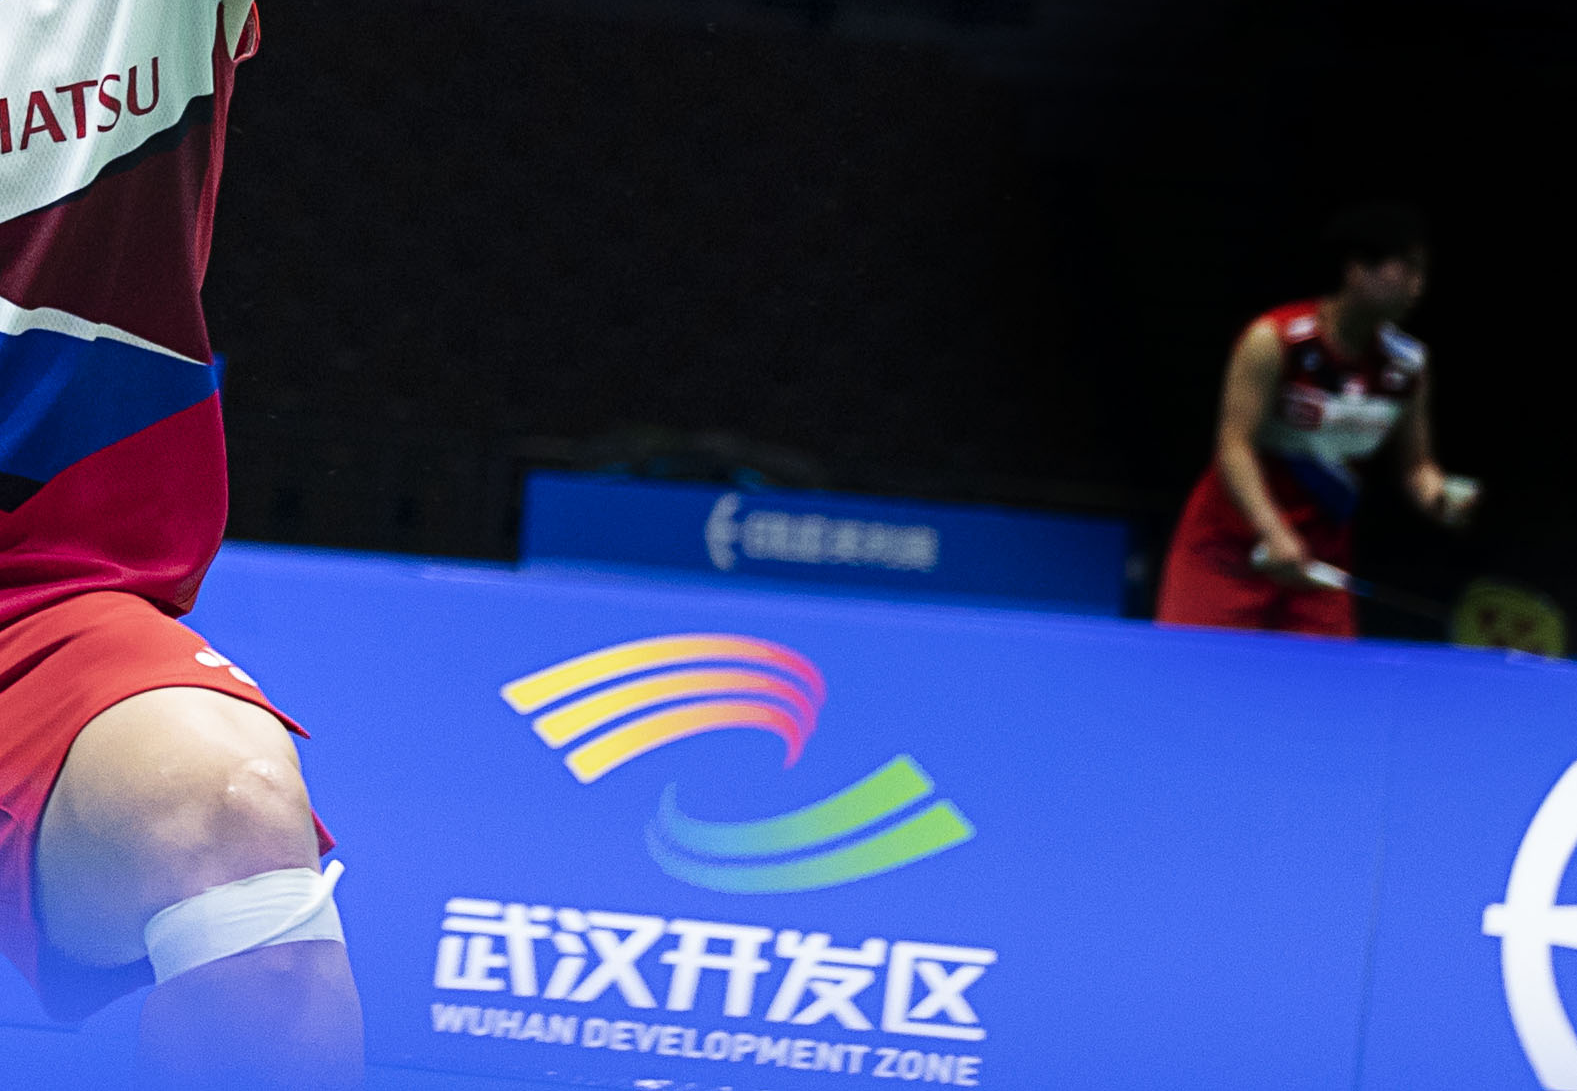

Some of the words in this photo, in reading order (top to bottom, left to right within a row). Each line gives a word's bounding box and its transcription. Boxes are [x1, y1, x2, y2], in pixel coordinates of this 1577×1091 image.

[433, 896, 998, 1041] 武汉开发区
[431, 1003, 578, 1046] WUHAN
[582, 1017, 871, 1075] DEVELOPMENT
[872, 1045, 983, 1088] ZONE
